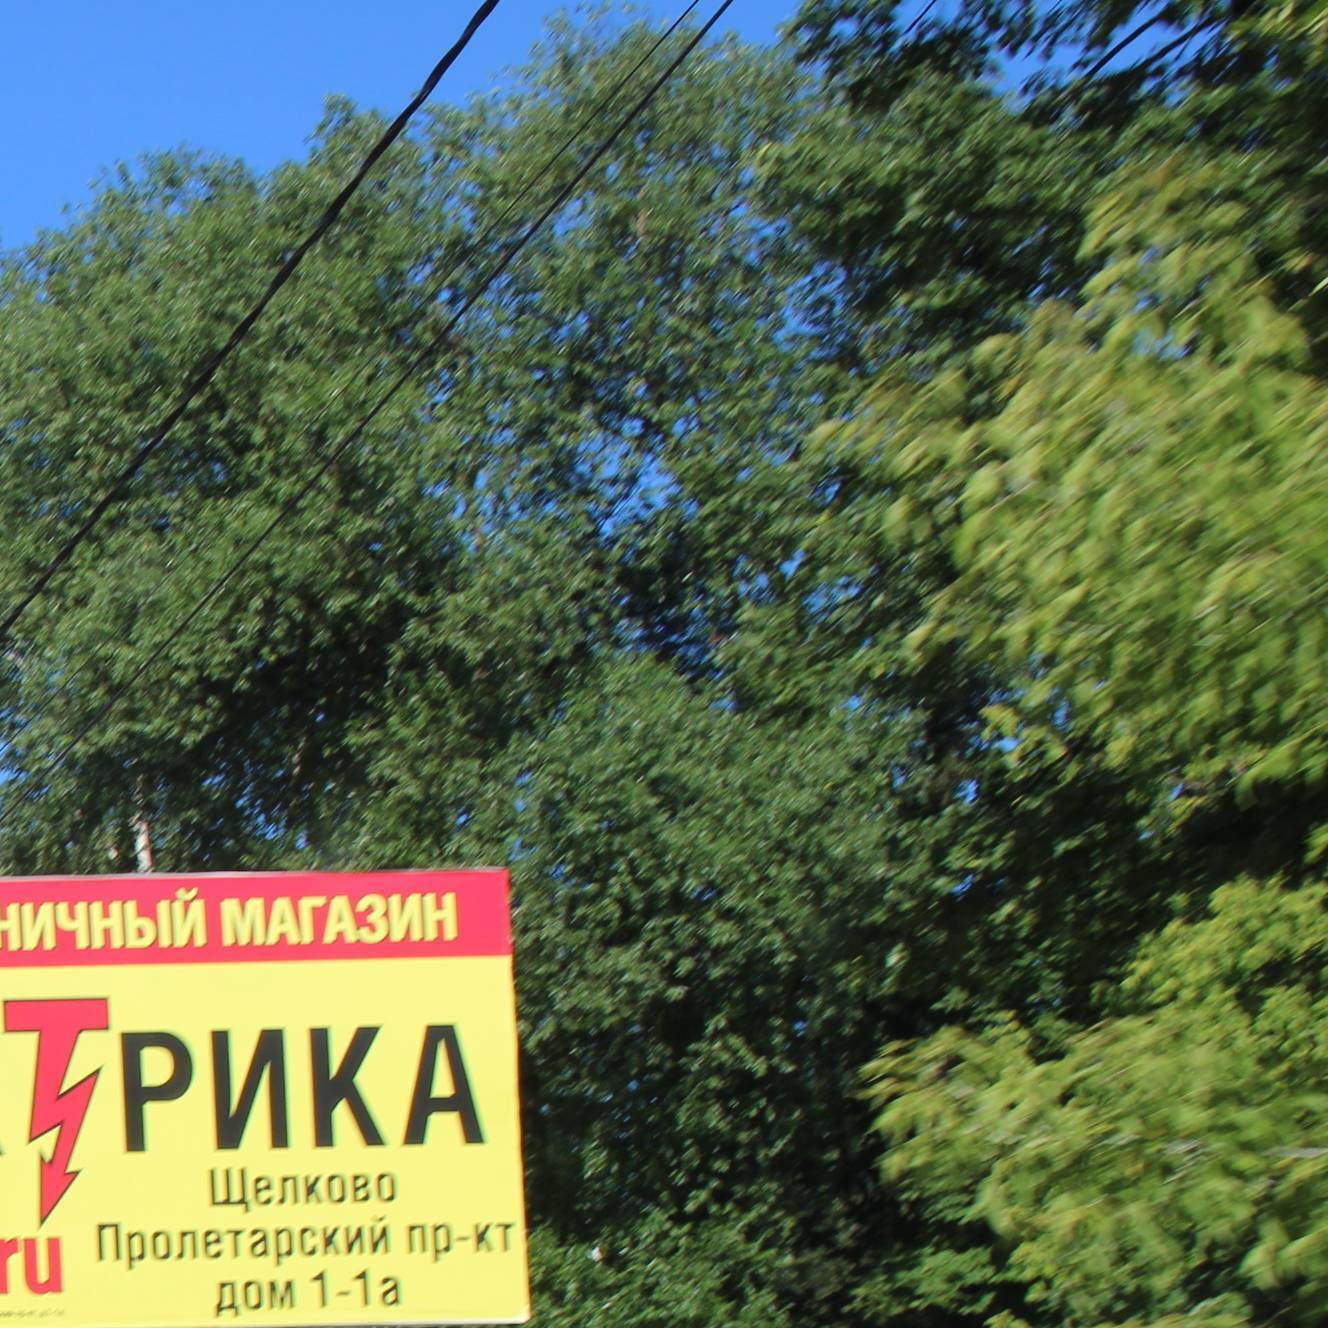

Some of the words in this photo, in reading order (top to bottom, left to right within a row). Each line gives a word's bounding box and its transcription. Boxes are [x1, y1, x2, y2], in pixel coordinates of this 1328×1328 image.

[219, 891, 459, 948] МАГАЗИН
[210, 1167, 398, 1213] Щелково
[96, 1216, 391, 1270] Пролетарский
[406, 1220, 516, 1262] пр-кт
[215, 1278, 296, 1318] дом
